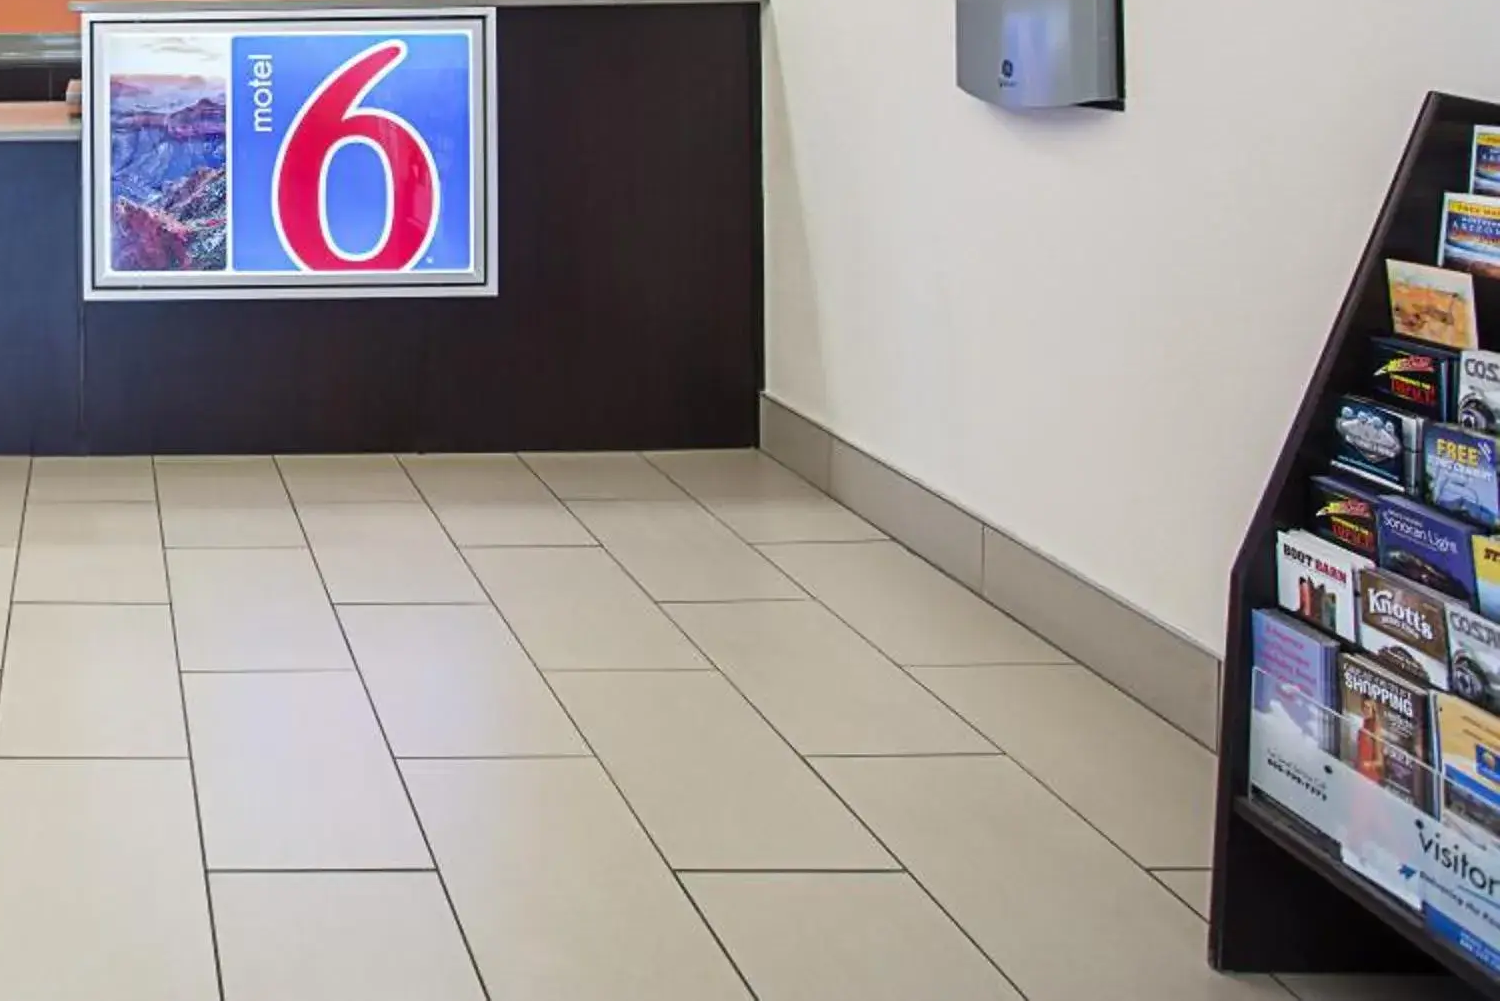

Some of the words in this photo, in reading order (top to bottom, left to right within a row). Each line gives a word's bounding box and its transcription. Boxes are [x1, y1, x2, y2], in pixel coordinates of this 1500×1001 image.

[248, 54, 273, 133] motel
[271, 38, 441, 272] 6
[1464, 358, 1500, 383] COS
[1436, 437, 1480, 468] FREE
[1382, 510, 1427, 541] Sonoran
[1283, 543, 1312, 565] BOOT
[1315, 558, 1347, 584] BARN
[1344, 669, 1413, 717] SHOPPING
